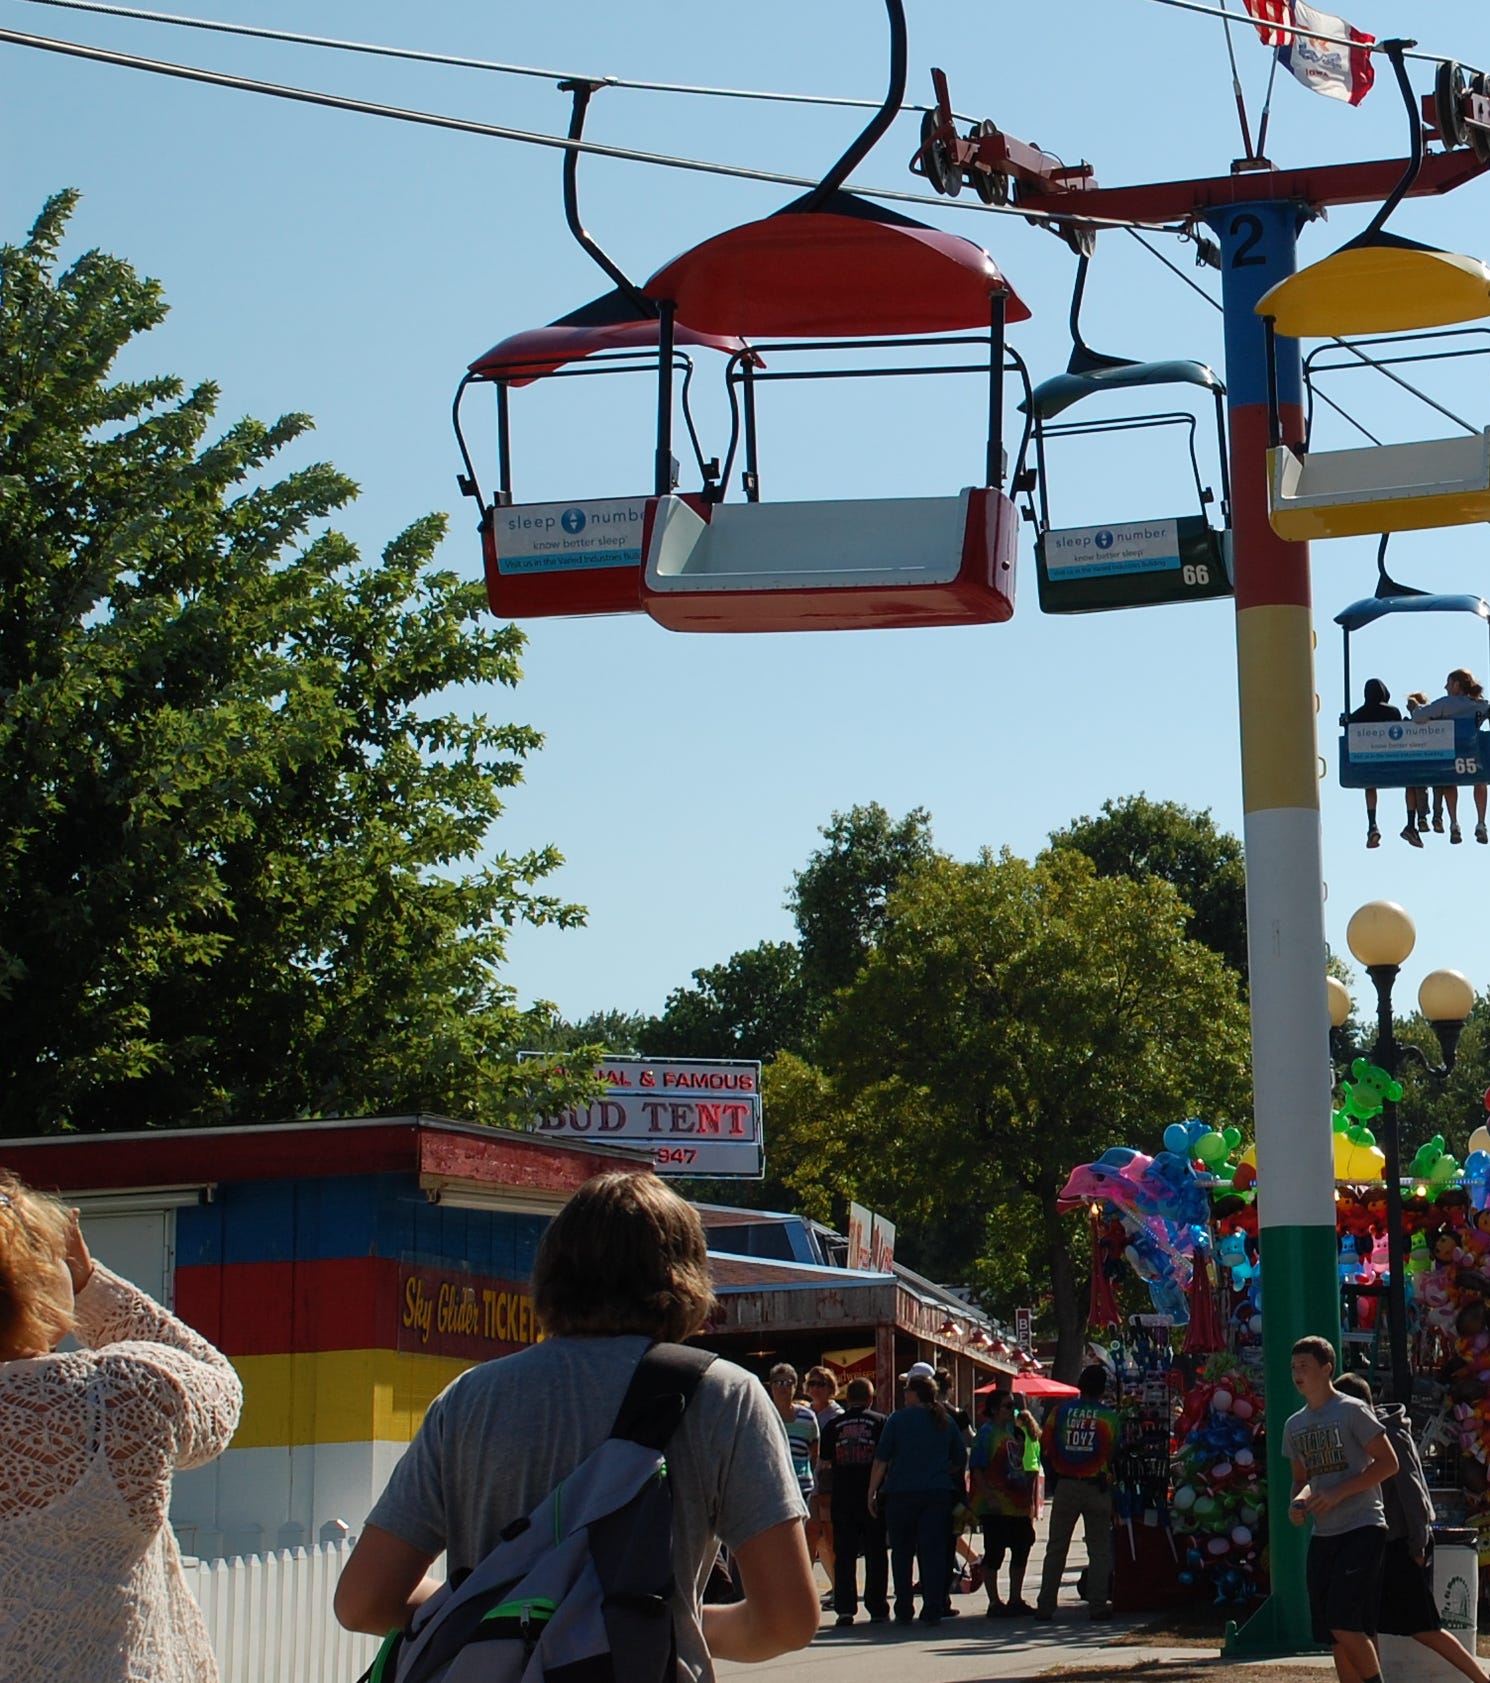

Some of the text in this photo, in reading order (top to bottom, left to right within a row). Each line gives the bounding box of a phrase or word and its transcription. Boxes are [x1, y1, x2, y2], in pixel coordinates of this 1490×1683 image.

[1230, 213, 1267, 269] 2
[508, 515, 556, 532] sleep
[533, 536, 626, 550] know better sleep
[1056, 528, 1166, 549] sleep number
[1183, 564, 1209, 585] 66
[1357, 727, 1446, 739] sleep number
[1455, 758, 1477, 775] 65
[639, 1070, 656, 1087] &
[663, 1071, 754, 1090] FAMOUS
[642, 1102, 750, 1135] TENT
[652, 1148, 698, 1165] 947
[403, 1276, 433, 1344] Sky
[437, 1283, 479, 1336] Glider
[1067, 1407, 1098, 1419] PEACE
[1066, 1417, 1087, 1430] LOVE
[1066, 1430, 1096, 1446] TOYZ
